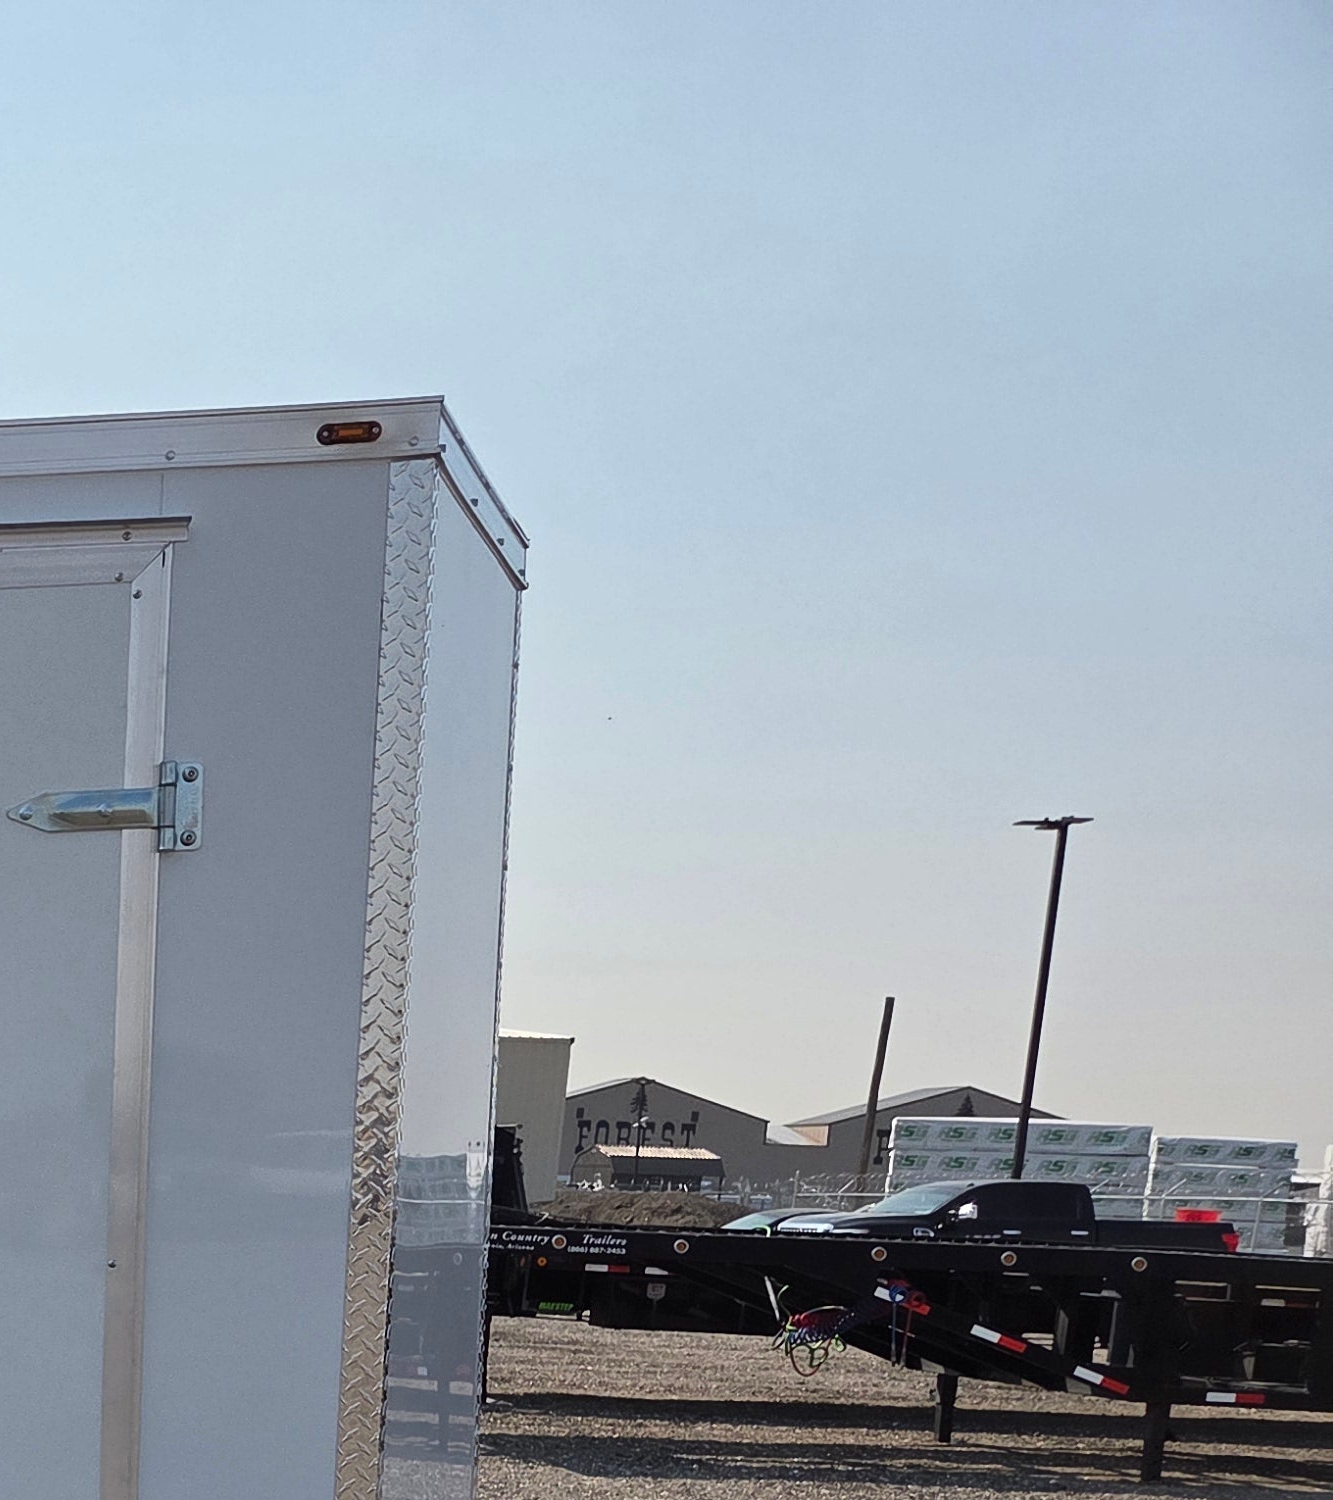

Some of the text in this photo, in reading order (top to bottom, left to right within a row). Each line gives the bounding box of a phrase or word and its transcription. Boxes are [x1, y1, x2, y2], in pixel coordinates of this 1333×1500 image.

[575, 1119, 697, 1155] FOREST
[991, 1128, 1016, 1140] RS
[502, 1231, 551, 1246] Country
[582, 1233, 628, 1246] Trailers
